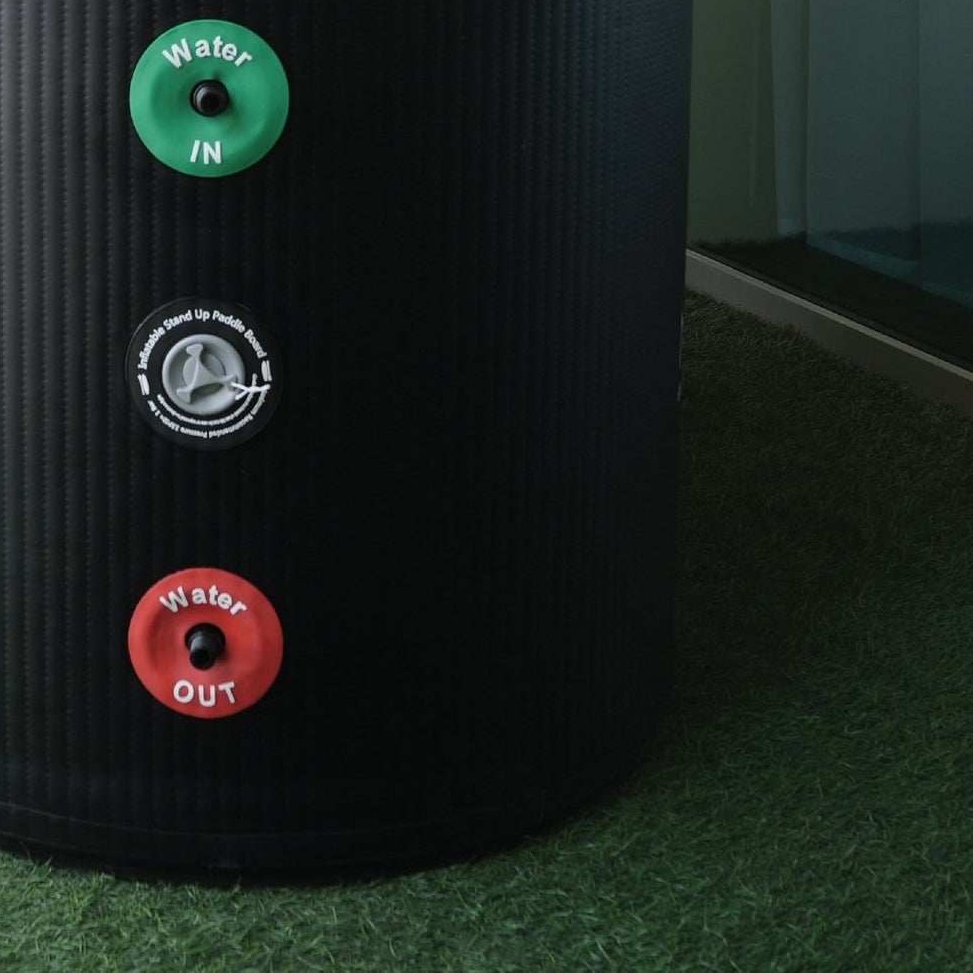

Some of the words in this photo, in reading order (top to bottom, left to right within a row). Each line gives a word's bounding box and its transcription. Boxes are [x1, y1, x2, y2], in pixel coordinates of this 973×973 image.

[161, 35, 253, 69] Water
[189, 139, 222, 165] IN
[137, 327, 166, 371] Inflatable
[163, 309, 193, 331] Stand
[195, 308, 211, 322] Up
[212, 309, 246, 333] Paddle
[244, 329, 268, 359] Board
[159, 584, 248, 615] Water
[173, 679, 236, 707] OUT
